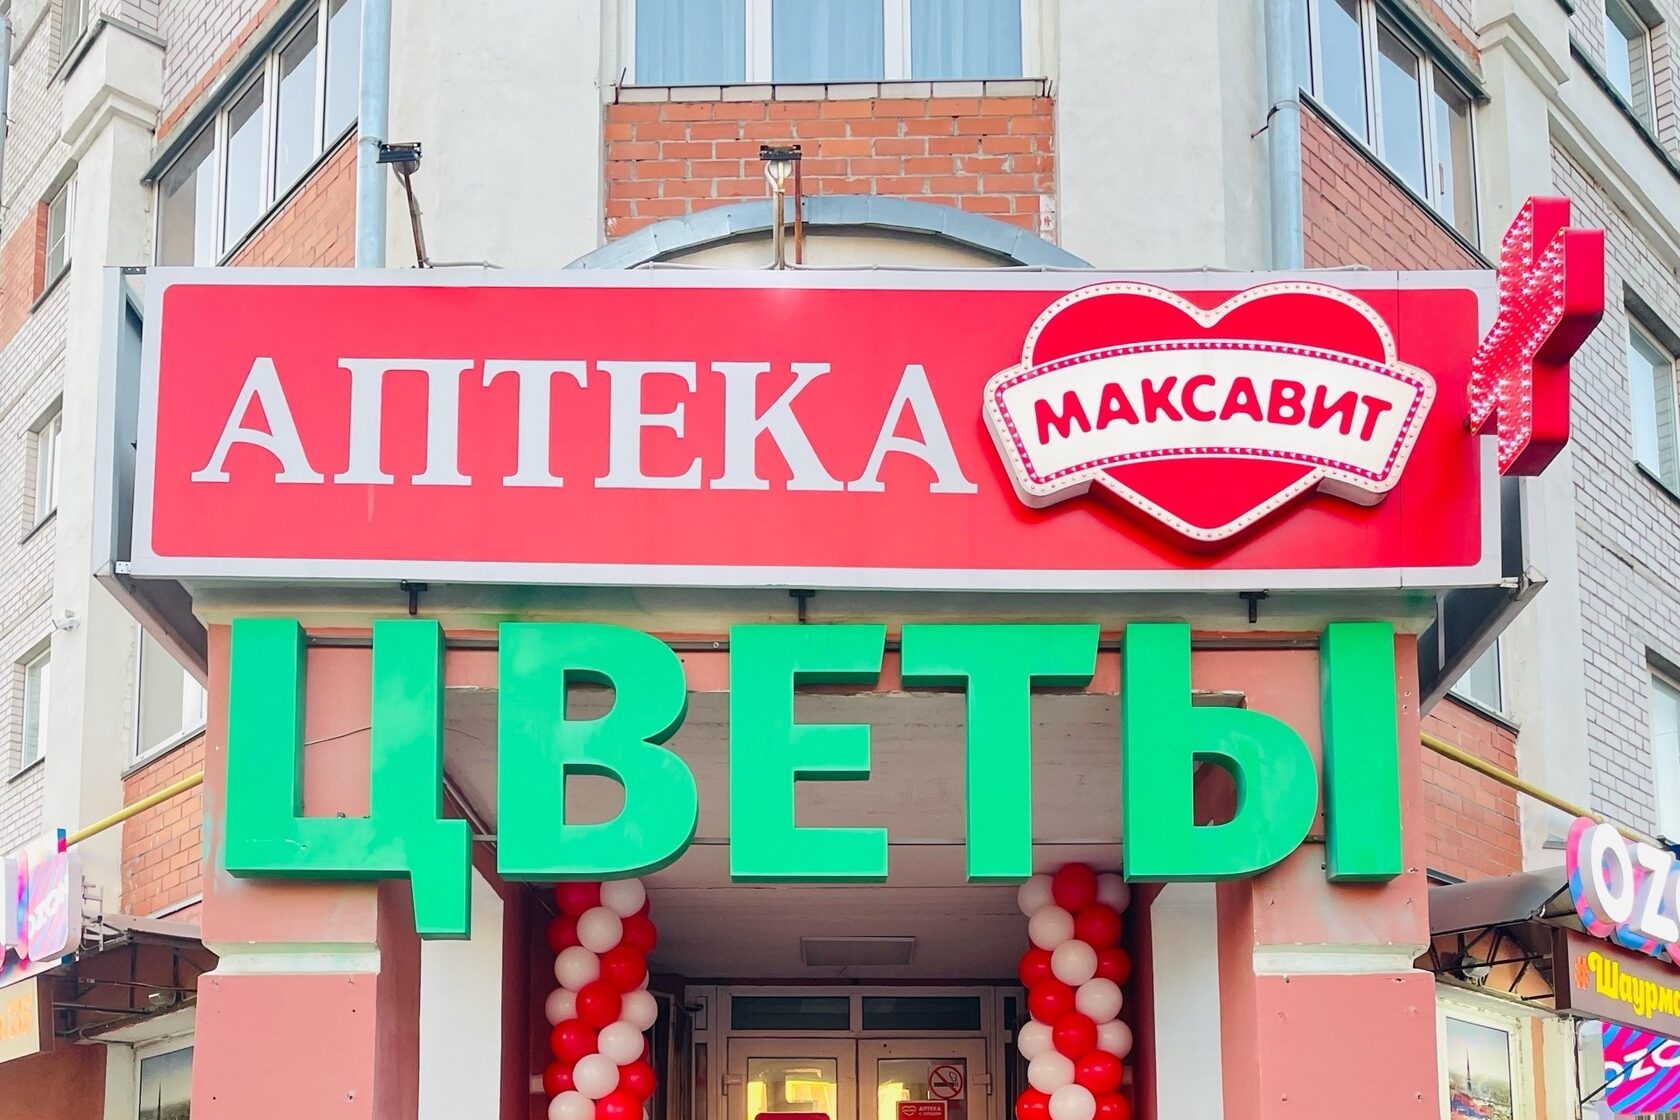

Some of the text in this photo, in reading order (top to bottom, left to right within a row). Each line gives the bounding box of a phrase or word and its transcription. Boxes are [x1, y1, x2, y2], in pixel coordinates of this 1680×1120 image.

[190, 356, 979, 497] АПТЕКА
[1033, 374, 1393, 446] МАКСАВИТ
[225, 618, 1403, 940] ЦВЕТЫ
[1580, 822, 1680, 944] OZ
